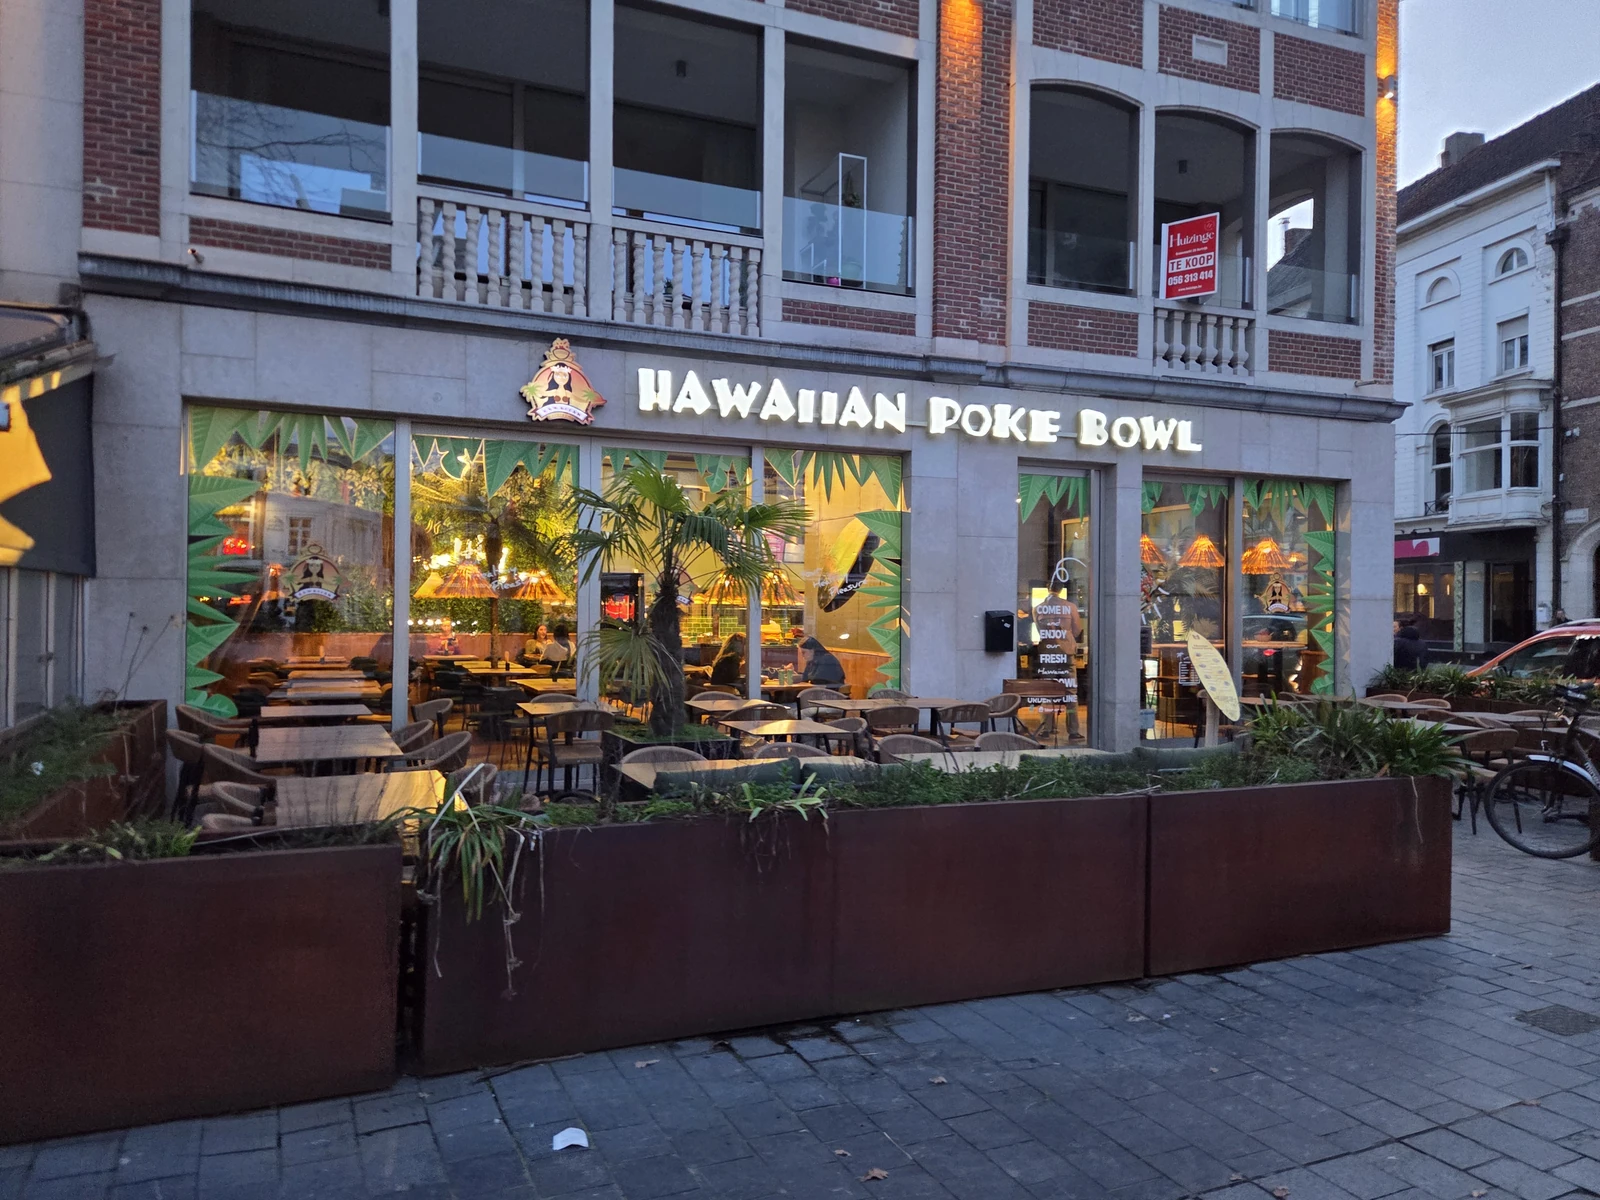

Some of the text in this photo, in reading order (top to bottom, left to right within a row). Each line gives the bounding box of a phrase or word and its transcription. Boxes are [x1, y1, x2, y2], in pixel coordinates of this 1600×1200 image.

[1169, 232, 1215, 247] Huizinge
[1170, 255, 1212, 271] TE KOOP
[1168, 269, 1213, 286] 056 313 414
[638, 368, 1202, 451] HAWAIIAN POKE BOWL
[1037, 605, 1071, 614] COME IN
[1047, 618, 1060, 627] and
[1040, 629, 1067, 639] ENJOY
[1040, 653, 1067, 664] FRESH
[1062, 694, 1077, 702] LINE
